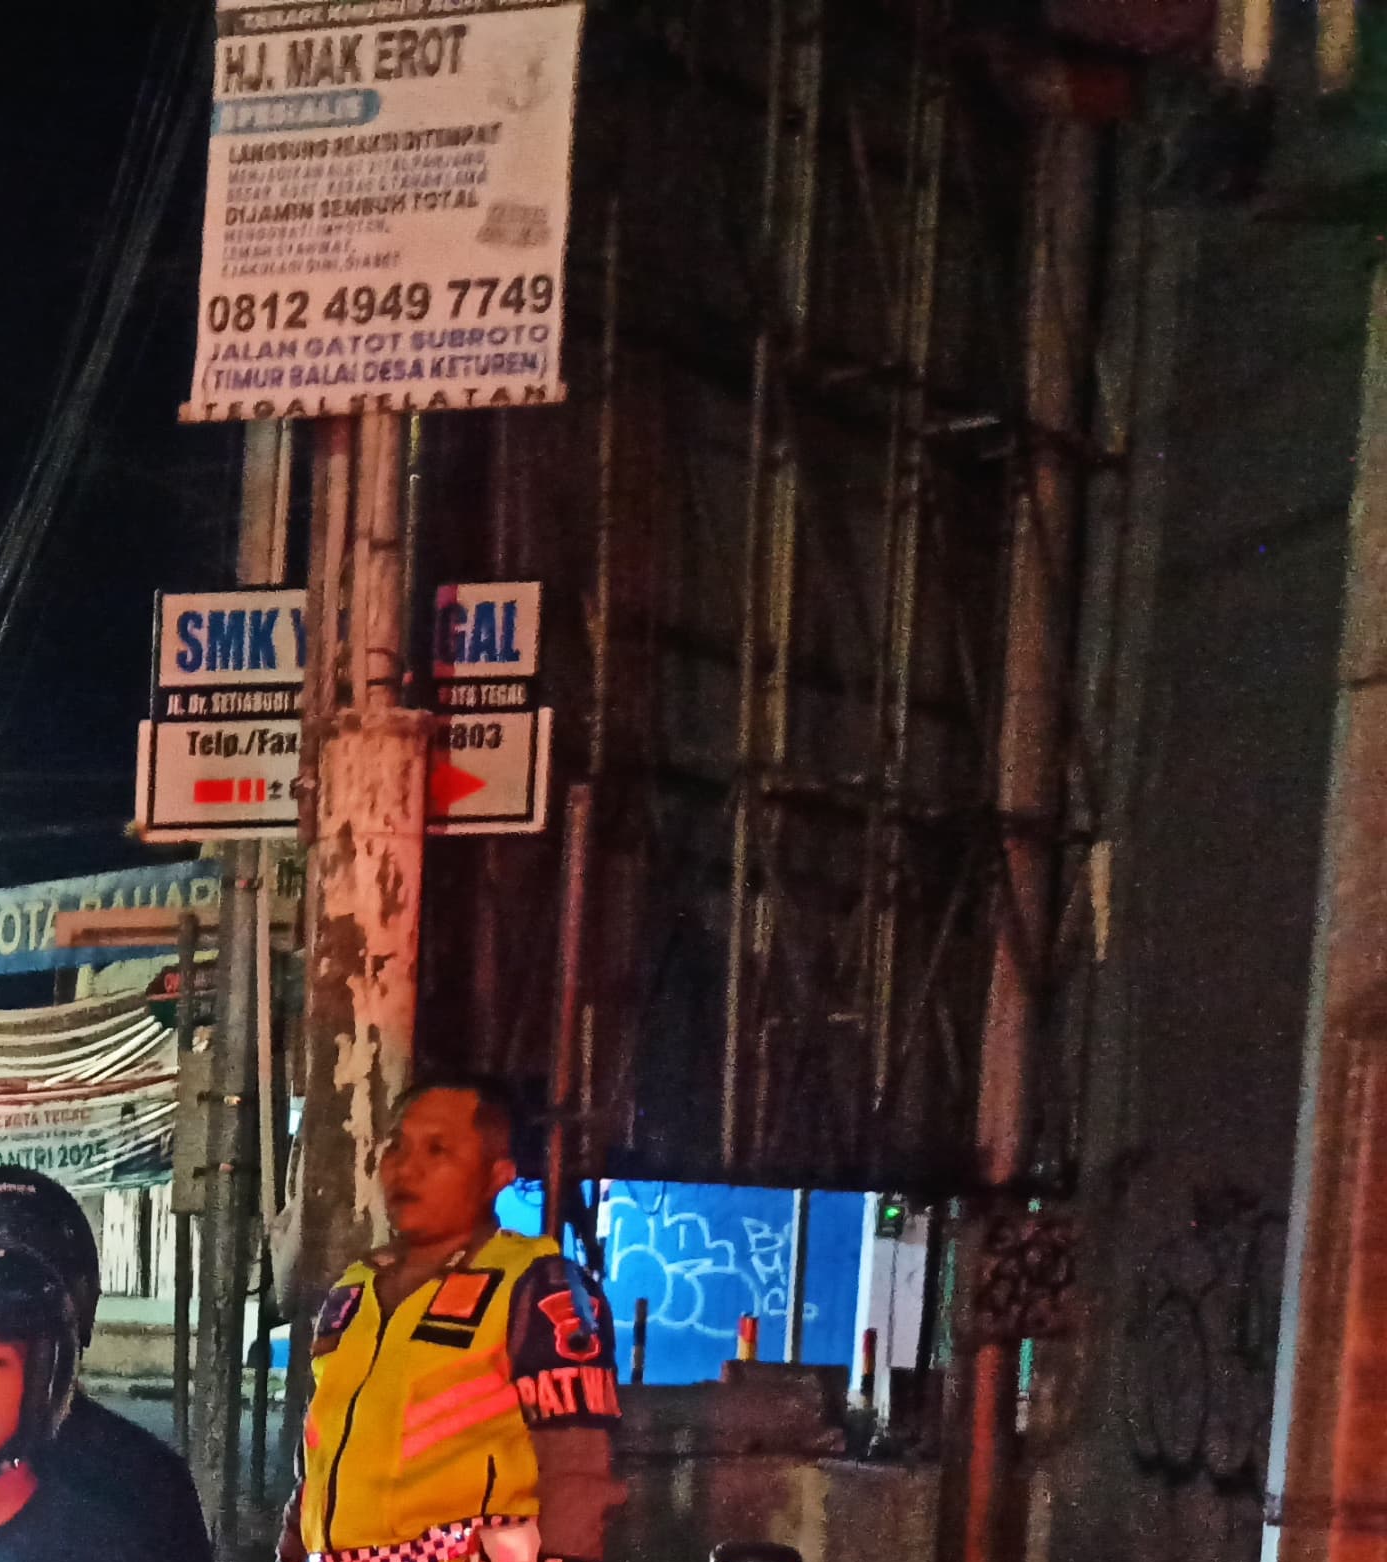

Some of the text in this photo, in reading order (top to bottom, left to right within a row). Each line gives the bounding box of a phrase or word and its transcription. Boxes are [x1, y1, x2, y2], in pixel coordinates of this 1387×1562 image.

[285, 33, 363, 88] MAK
[374, 23, 468, 81] EROT
[225, 201, 315, 226] DIJAMIN
[207, 273, 555, 334] 0812 4949 7749
[211, 323, 550, 363] JALAN GATOT SUBROTO
[288, 358, 358, 389] BALAI
[361, 355, 426, 385] DESA
[176, 607, 279, 674] SMK
